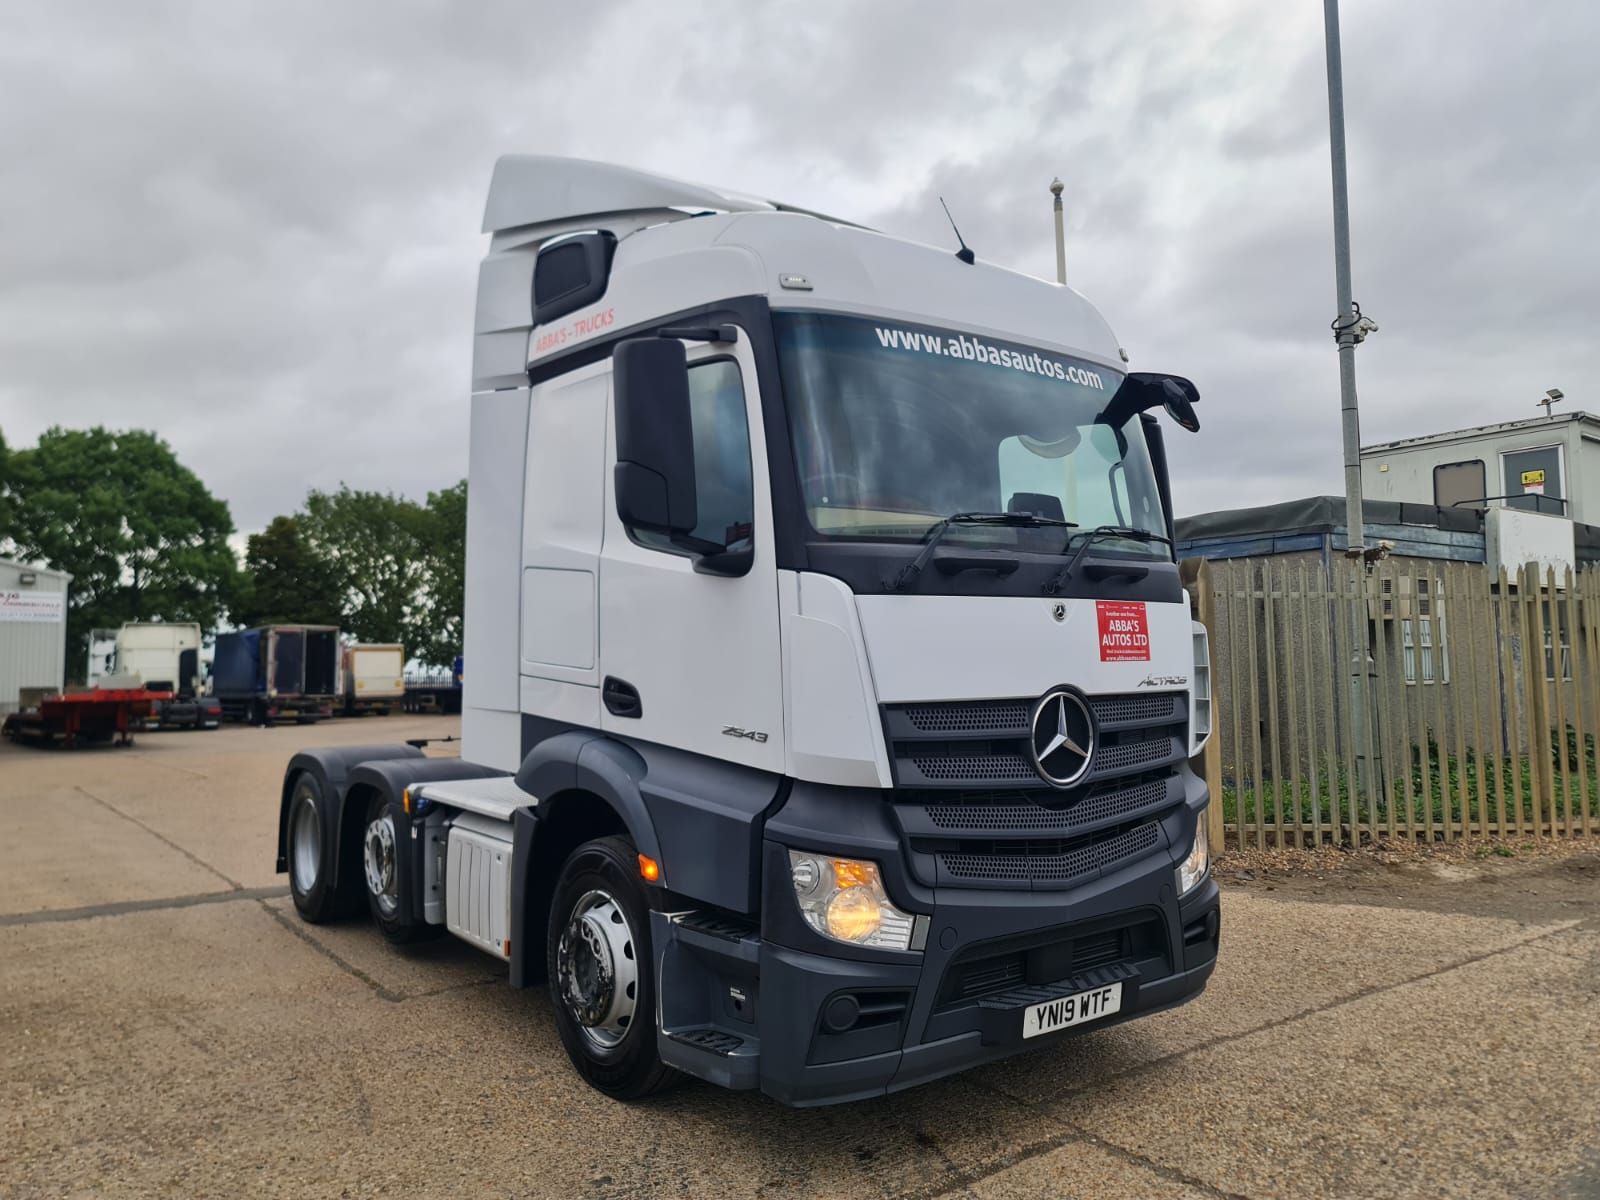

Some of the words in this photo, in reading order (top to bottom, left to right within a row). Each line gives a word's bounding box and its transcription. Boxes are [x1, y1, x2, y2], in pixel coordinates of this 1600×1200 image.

[875, 327, 1104, 390] www.abbasautos.com
[1109, 619, 1140, 632] ABBA'S
[1102, 633, 1132, 646] AUTOS
[1133, 634, 1148, 646] LTD
[721, 725, 769, 743] 2543
[1036, 998, 1075, 1030] YN19
[1080, 988, 1112, 1019] WTF
